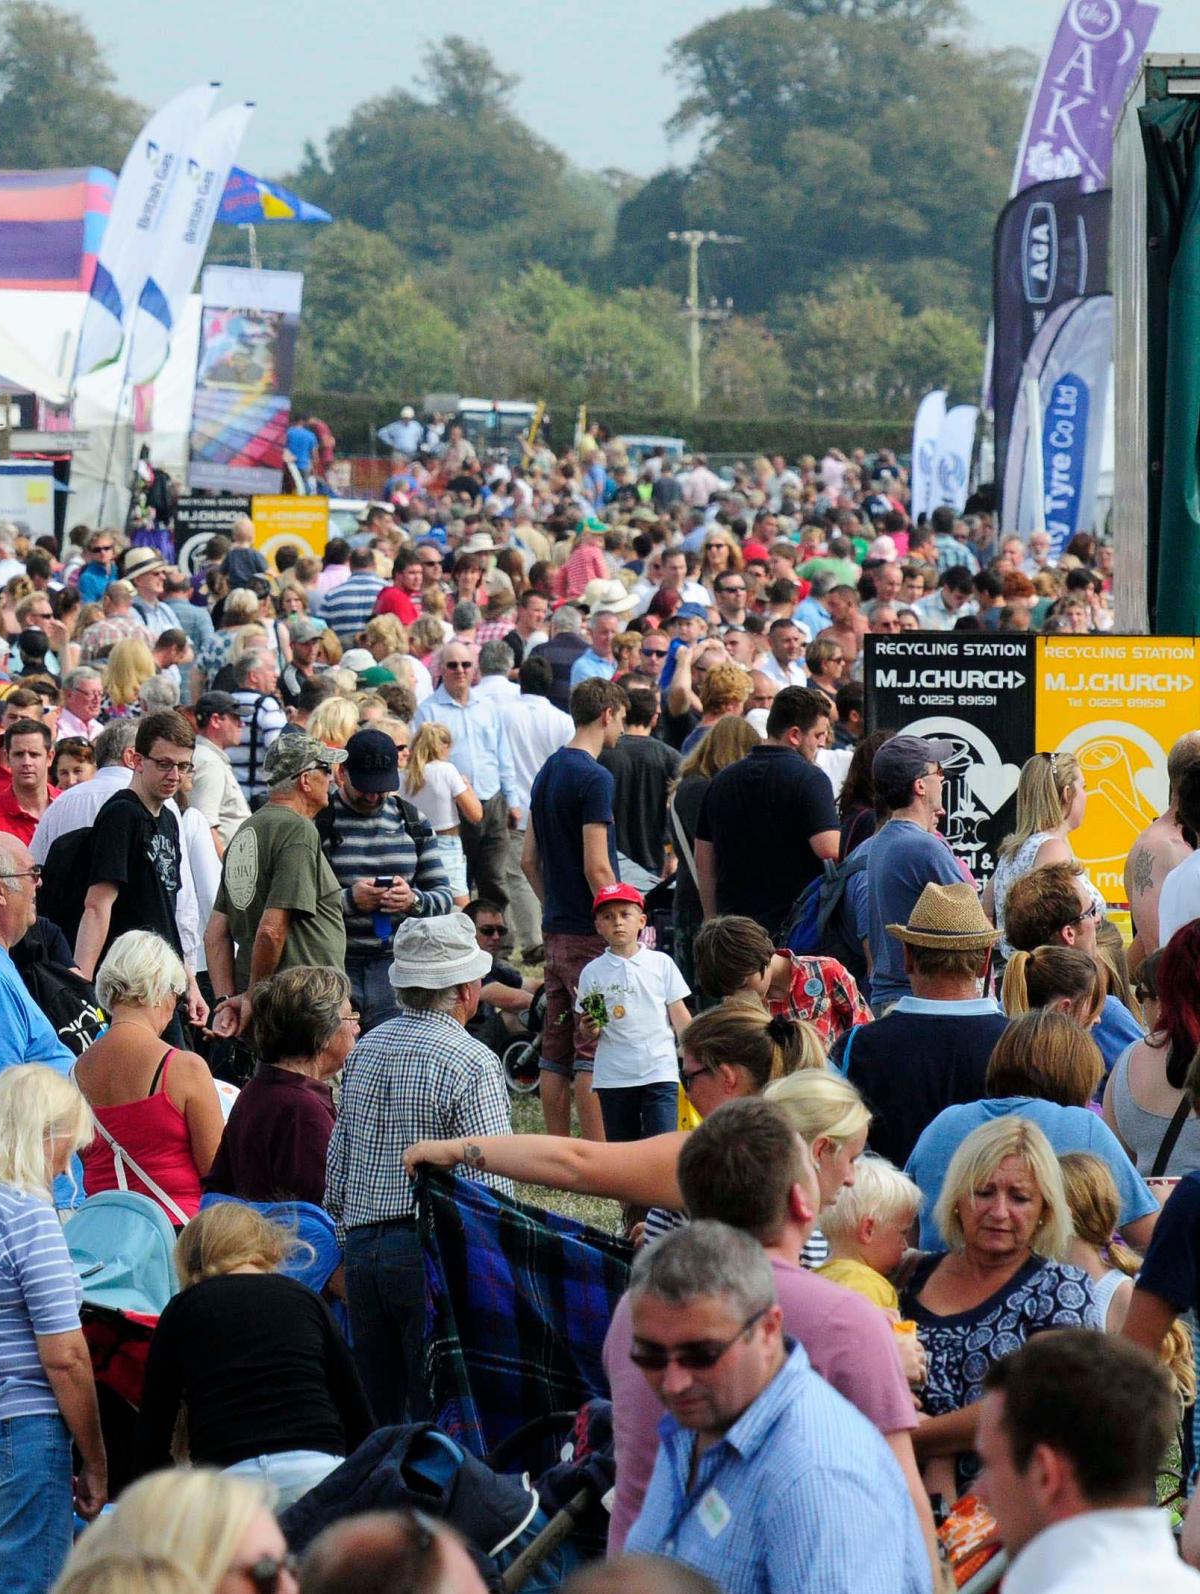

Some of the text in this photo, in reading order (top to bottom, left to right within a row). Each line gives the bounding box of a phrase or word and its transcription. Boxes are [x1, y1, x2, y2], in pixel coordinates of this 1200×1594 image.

[1030, 222, 1050, 282] AGA
[1052, 384, 1079, 417] Ltd
[1050, 419, 1075, 449] Co
[1044, 452, 1076, 515] Tyre
[875, 642, 1027, 656] RECYCLING STATION
[1044, 646, 1196, 660] RECYCLING STATION
[898, 694, 997, 706] Tel: 01225 891591
[980, 852, 994, 869] &
